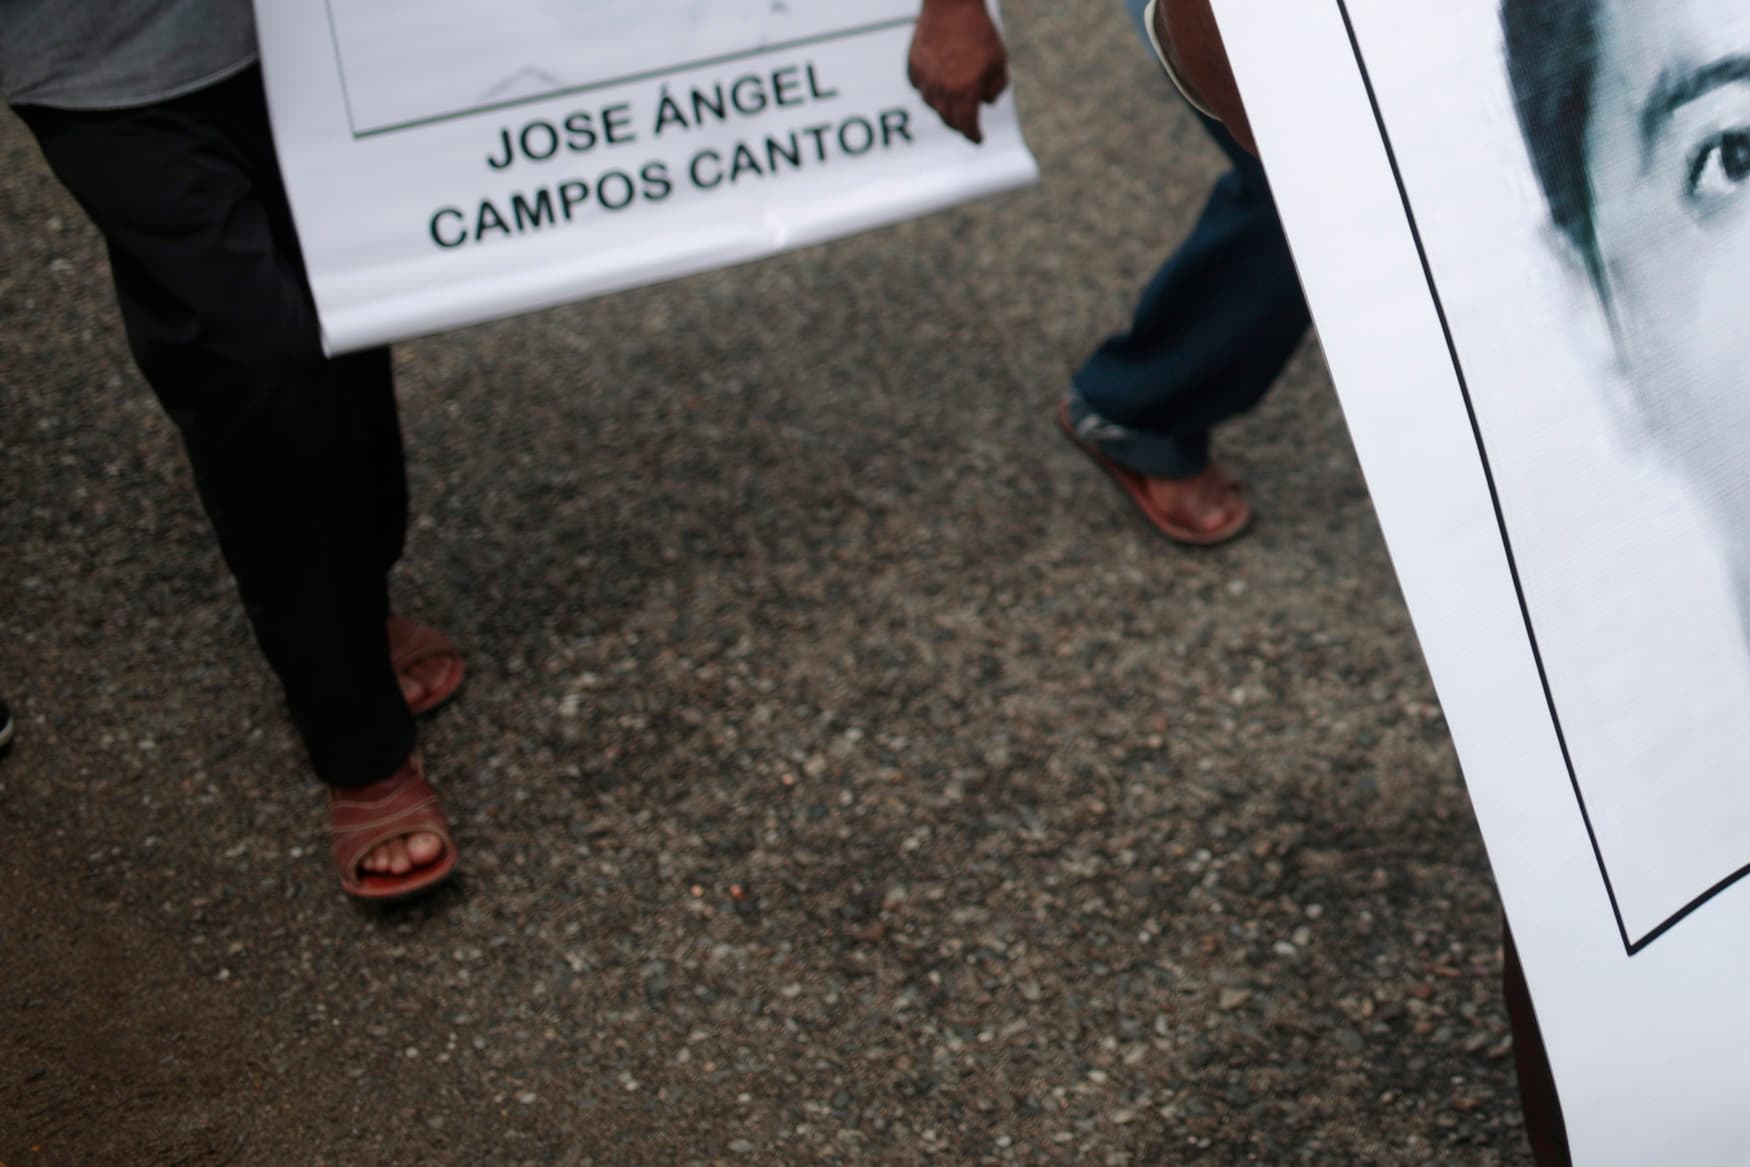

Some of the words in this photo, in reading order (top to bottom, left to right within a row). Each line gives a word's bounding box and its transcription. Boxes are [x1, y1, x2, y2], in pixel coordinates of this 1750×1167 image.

[428, 161, 674, 249] CAMPOS
[687, 107, 916, 191] CANTOR
[486, 103, 636, 171] JOSE
[653, 62, 839, 137] ÁNGEL
